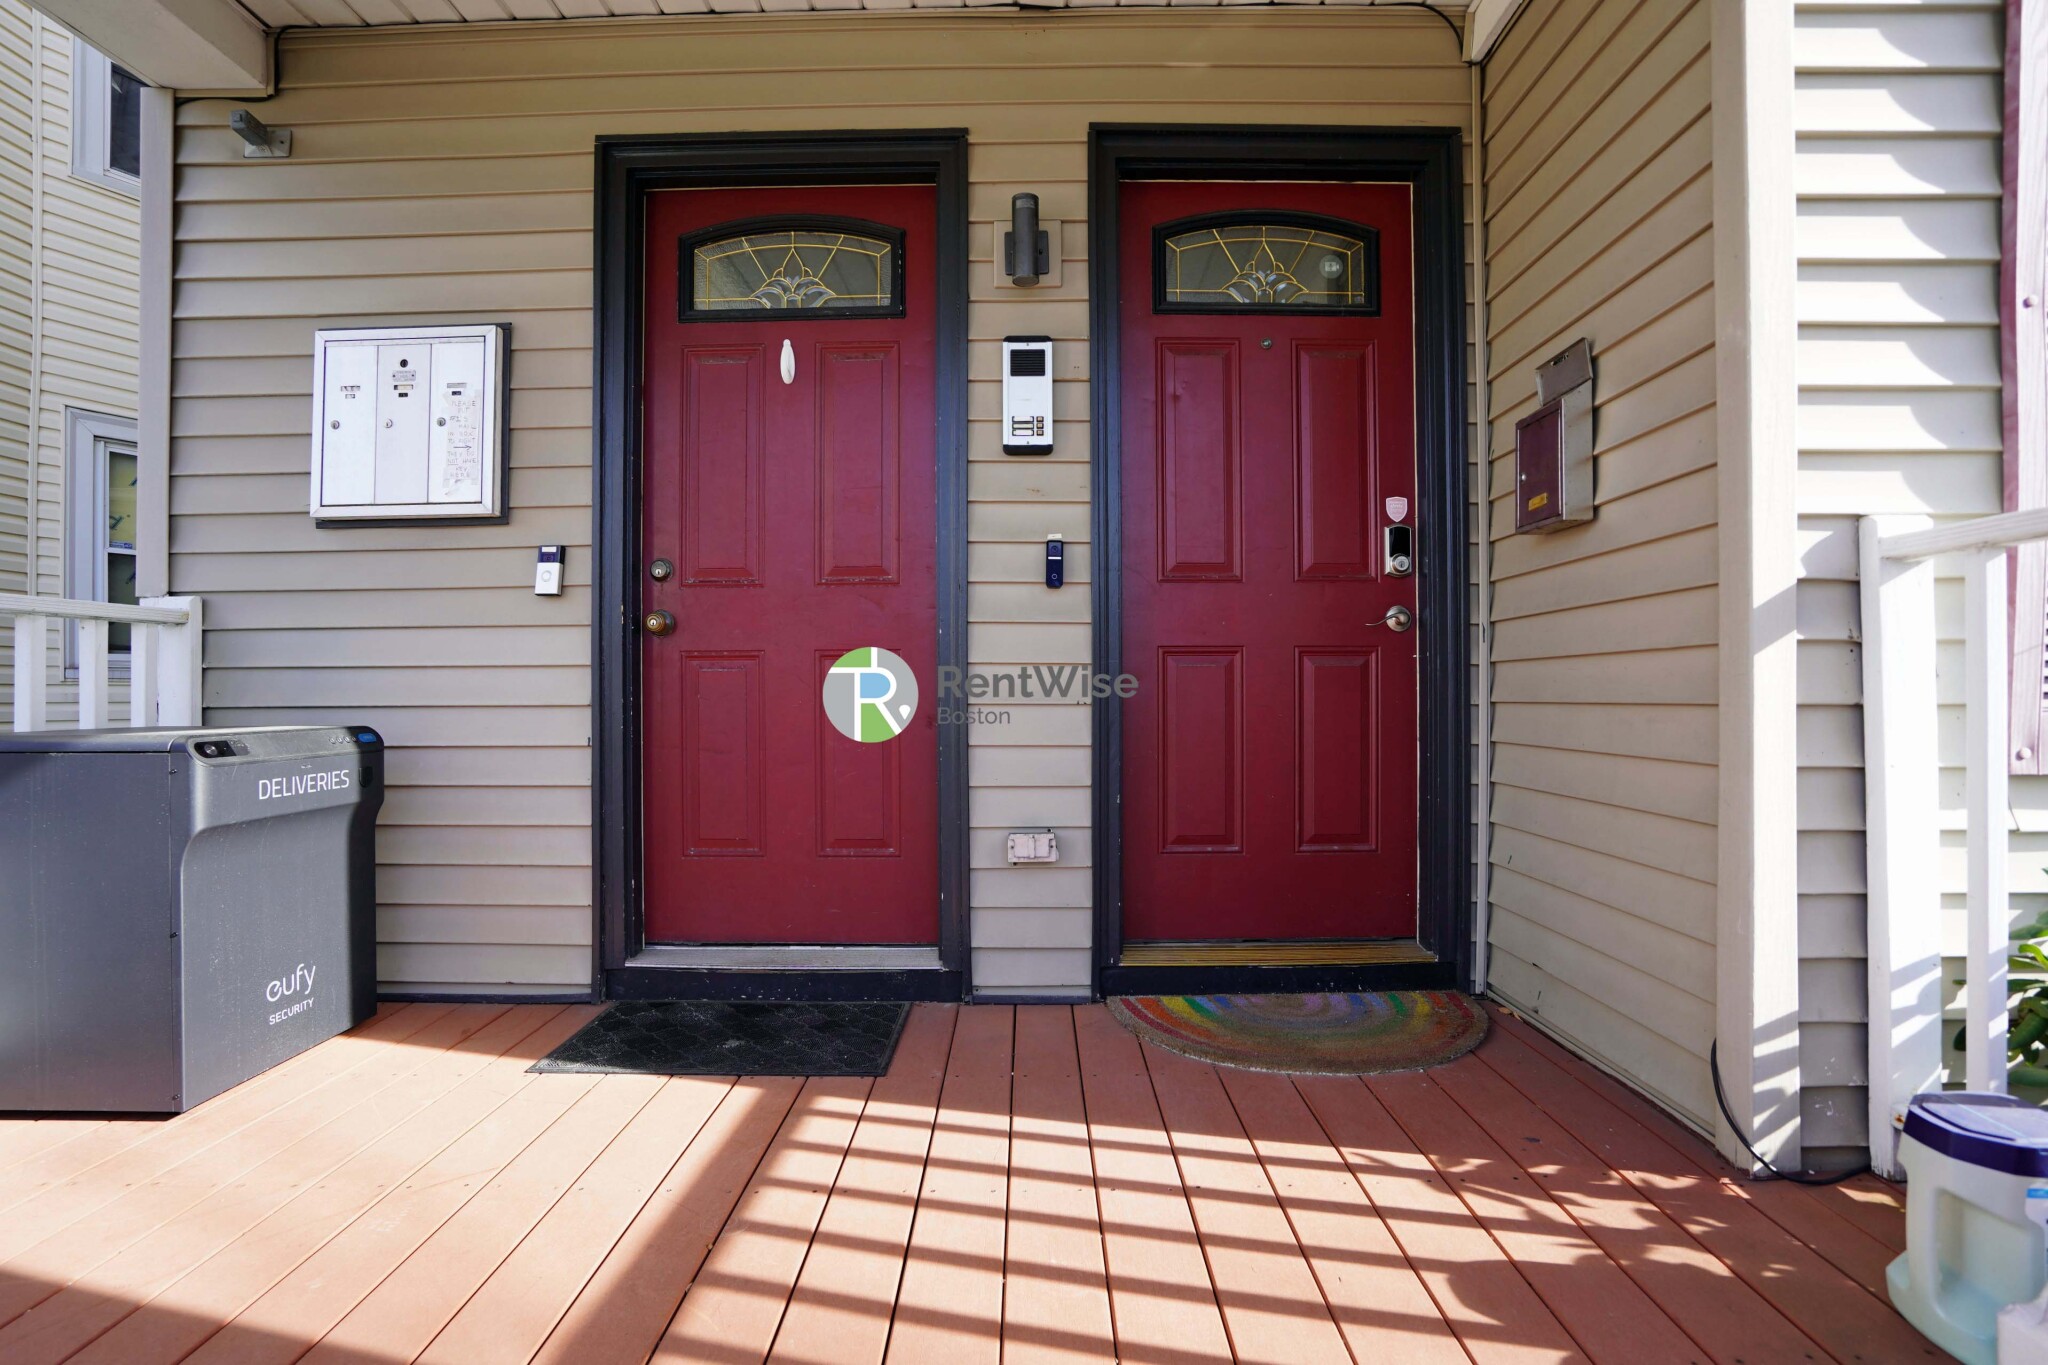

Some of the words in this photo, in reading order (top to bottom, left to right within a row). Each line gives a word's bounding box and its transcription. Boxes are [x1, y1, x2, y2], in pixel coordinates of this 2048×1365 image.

[259, 770, 350, 800] DELIVERIES
[266, 963, 316, 1002] eufy
[269, 997, 315, 1025] SECURITY
